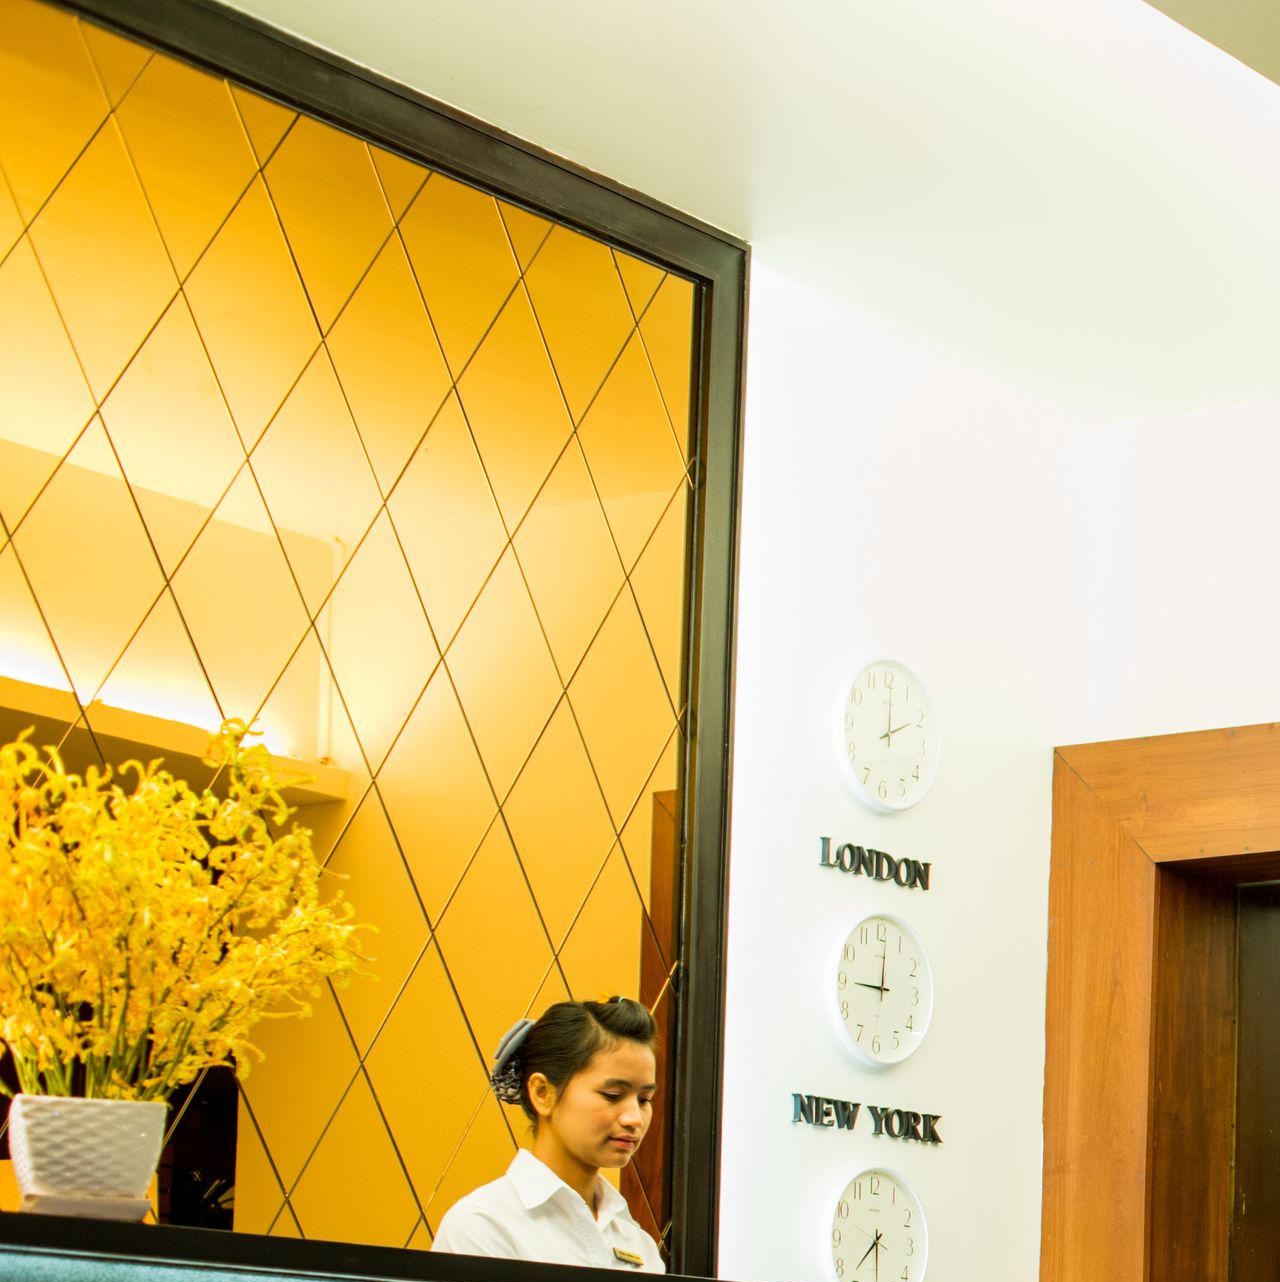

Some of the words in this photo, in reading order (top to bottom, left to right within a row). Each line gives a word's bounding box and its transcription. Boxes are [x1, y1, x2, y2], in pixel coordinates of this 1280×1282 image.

[867, 671, 876, 690] 11
[884, 670, 894, 690] 12
[916, 708, 924, 729] 2
[863, 766, 871, 785] 7
[911, 764, 920, 783] 4
[878, 779, 887, 800] 6
[898, 778, 906, 798] 5
[819, 836, 933, 891] LONDON
[860, 926, 868, 945] 11
[876, 922, 887, 943] 12
[843, 943, 856, 963] 10
[909, 958, 917, 978] 2
[838, 970, 848, 991] 9
[911, 987, 919, 1006] 3
[840, 1000, 849, 1020] 8
[856, 1023, 864, 1042] 7
[905, 1014, 913, 1033] 4
[871, 1034, 881, 1055] 6
[892, 1030, 900, 1050] 5
[791, 1093, 861, 1130] NEW
[866, 1105, 944, 1144] YORK
[853, 1182, 862, 1200] 11
[870, 1176, 881, 1196] 12
[837, 1200, 849, 1220] 10
[903, 1208, 912, 1228] 2
[832, 1228, 842, 1248] 9
[905, 1237, 914, 1257] 3
[835, 1257, 844, 1278] 8
